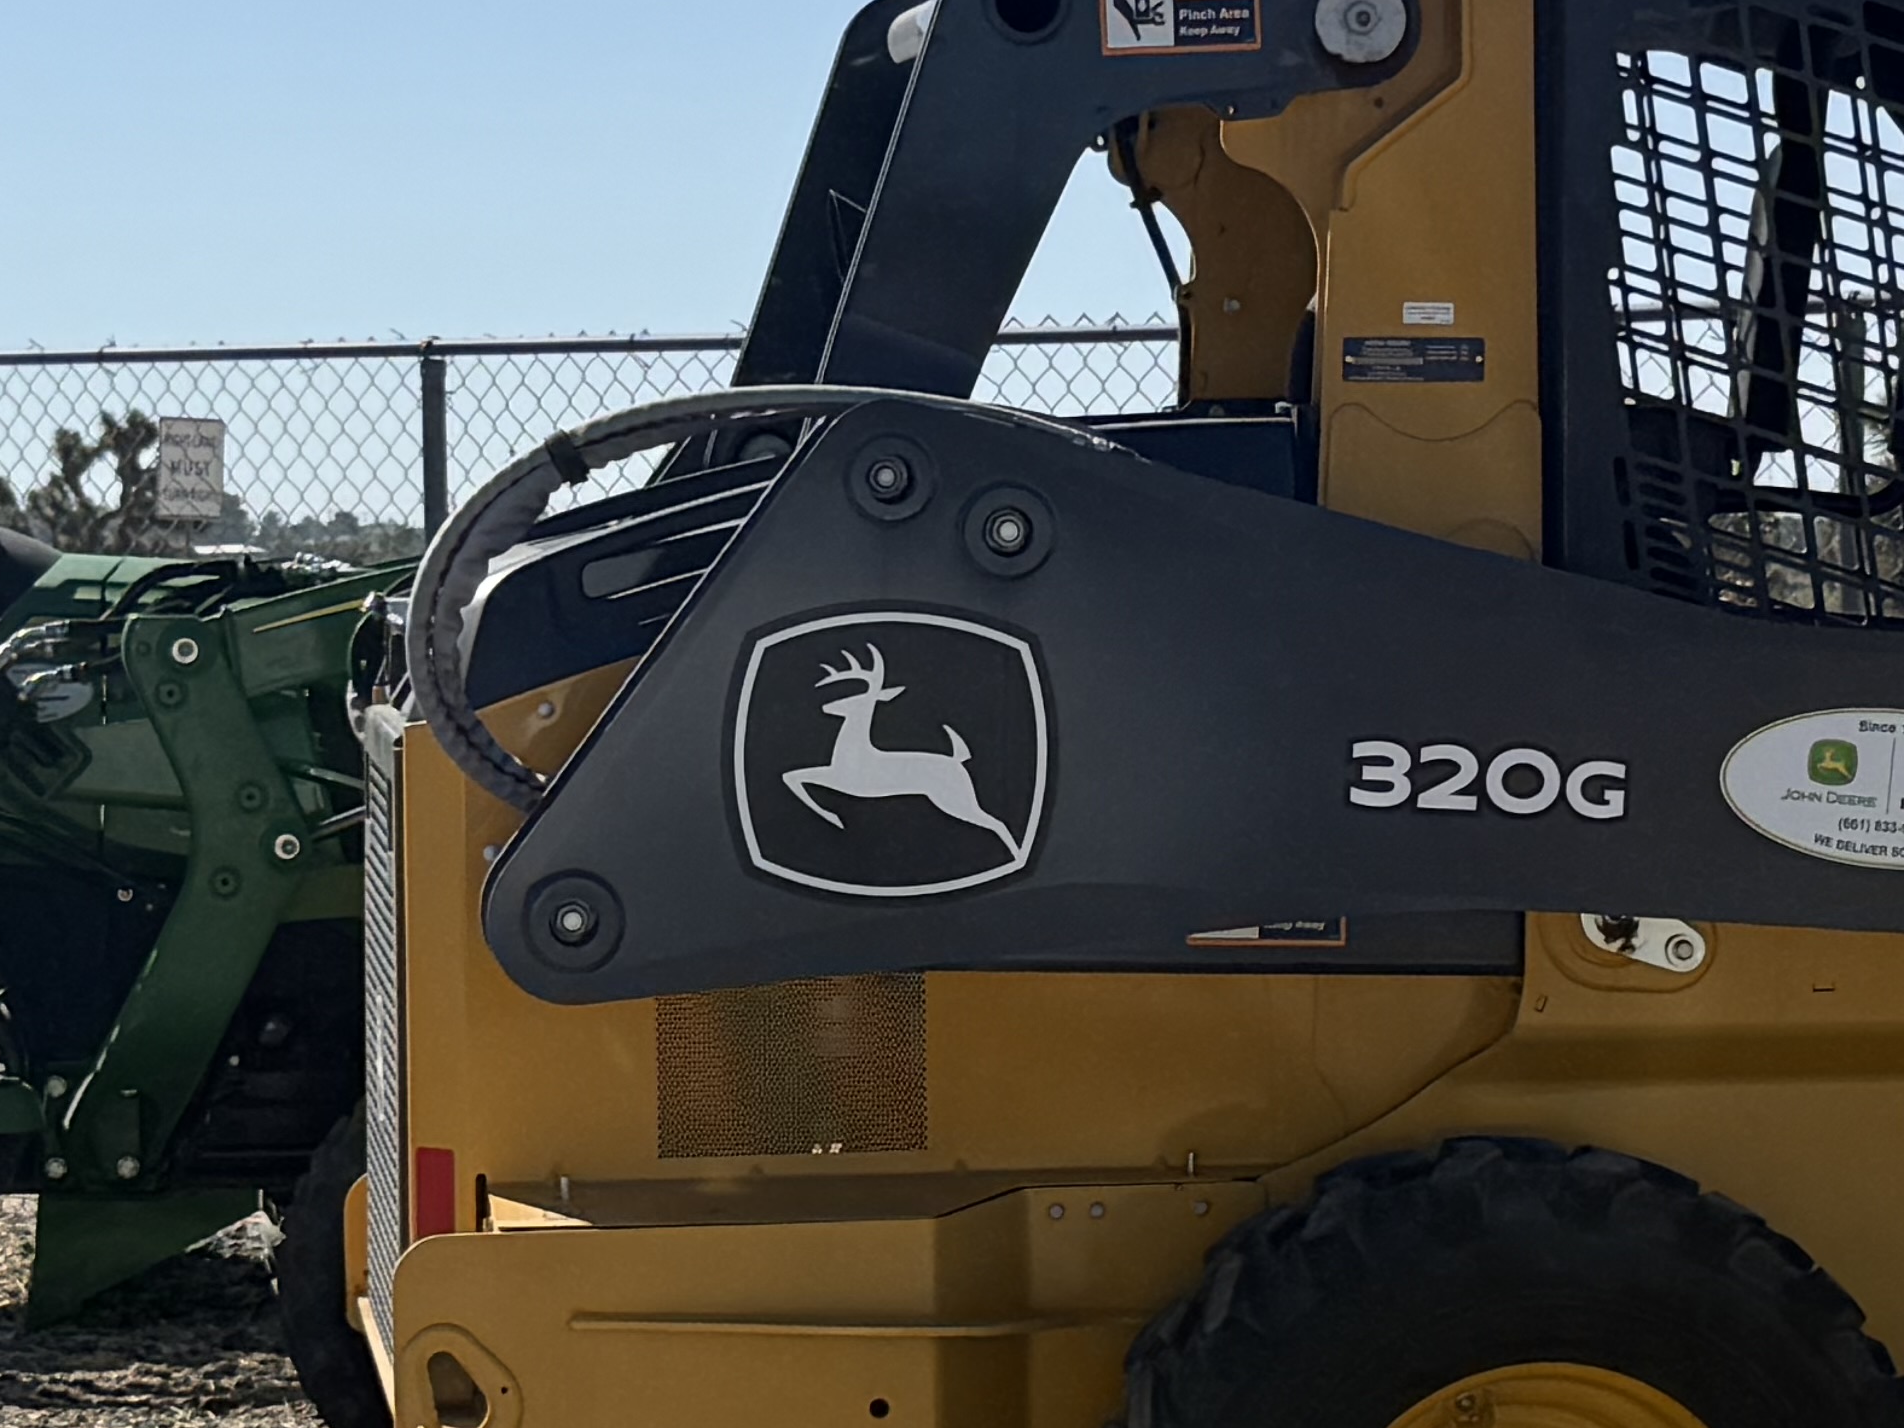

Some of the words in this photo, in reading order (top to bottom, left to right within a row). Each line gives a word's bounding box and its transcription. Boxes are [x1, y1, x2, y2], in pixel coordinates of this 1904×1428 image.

[1179, 8, 1216, 20] Pinch
[1219, 8, 1250, 19] Area
[1179, 25, 1208, 37] Keep
[1210, 25, 1241, 36] Away
[1859, 720, 1896, 733] Since
[1350, 740, 1626, 819] 320G
[1780, 788, 1823, 803] JOHN
[1826, 791, 1878, 808] DEERE
[1814, 832, 1833, 847] WE
[1836, 838, 1888, 856] DELIVER
